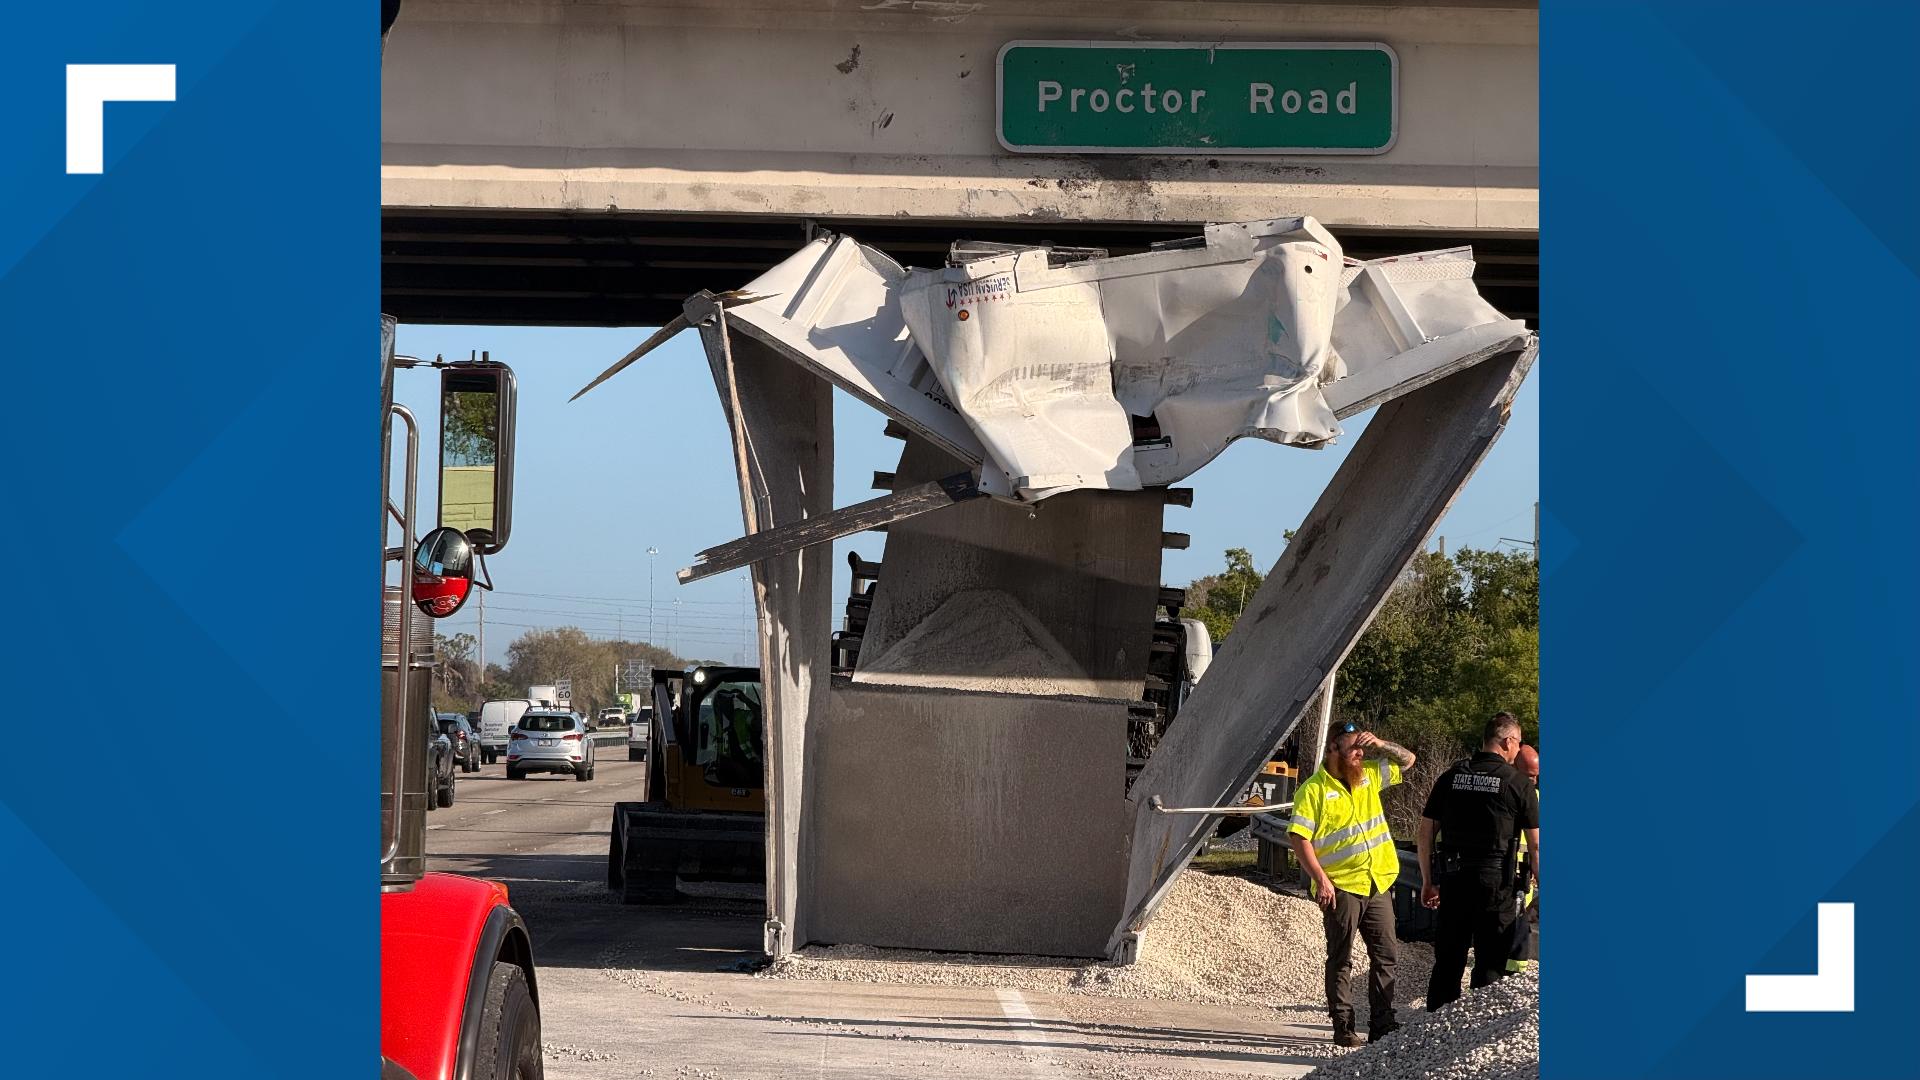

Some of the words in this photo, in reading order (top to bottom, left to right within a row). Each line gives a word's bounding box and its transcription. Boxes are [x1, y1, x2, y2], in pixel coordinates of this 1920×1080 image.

[1037, 81, 1207, 114] Proctor
[1249, 81, 1357, 114] Road
[957, 282, 974, 297] USA
[558, 690, 571, 699] 60
[1453, 773, 1473, 785] STATE
[1473, 774, 1501, 788] TROOPER
[1452, 783, 1473, 791] TRAFFIC
[1473, 785, 1500, 794] HOMICIDE
